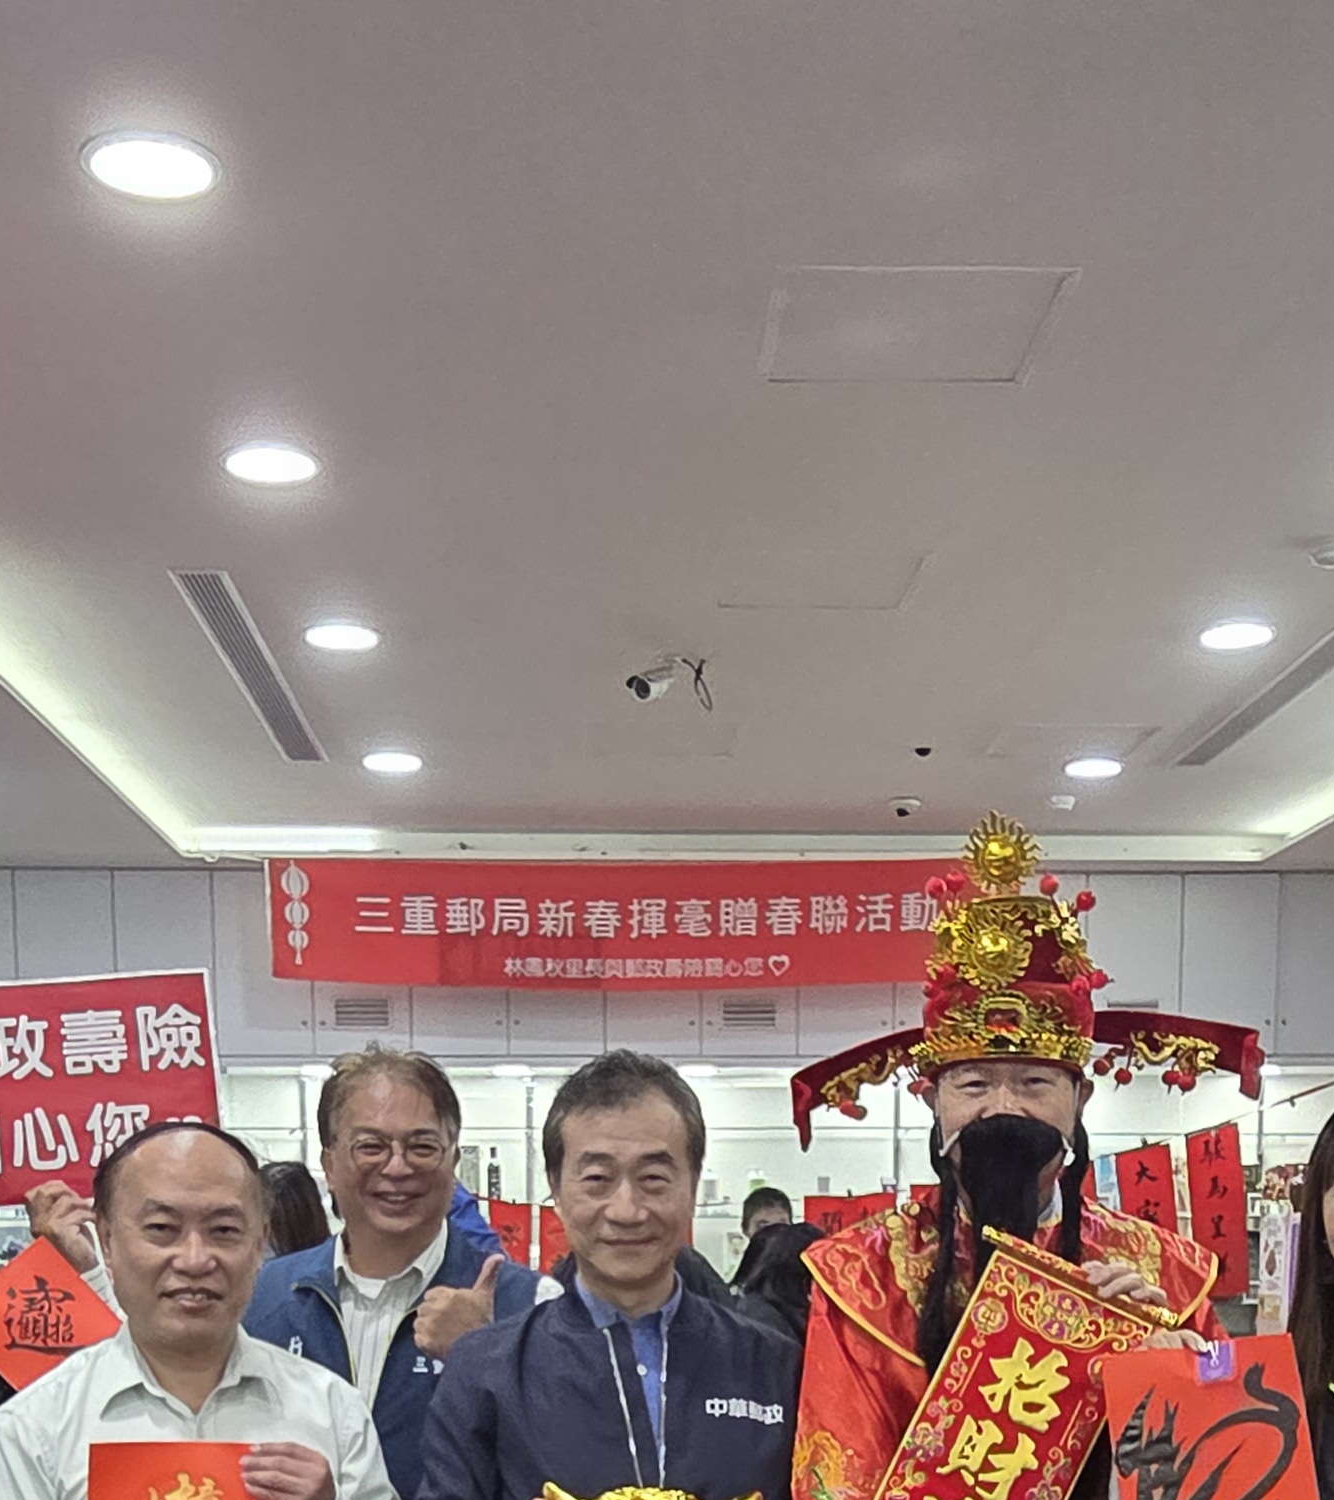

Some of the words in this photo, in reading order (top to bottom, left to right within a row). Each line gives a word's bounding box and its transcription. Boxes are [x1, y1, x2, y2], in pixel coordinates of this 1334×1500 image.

[355, 892, 939, 939] 三重郵局新春揮毫贈春聯活動
[705, 1398, 784, 1425] 中華郵政
